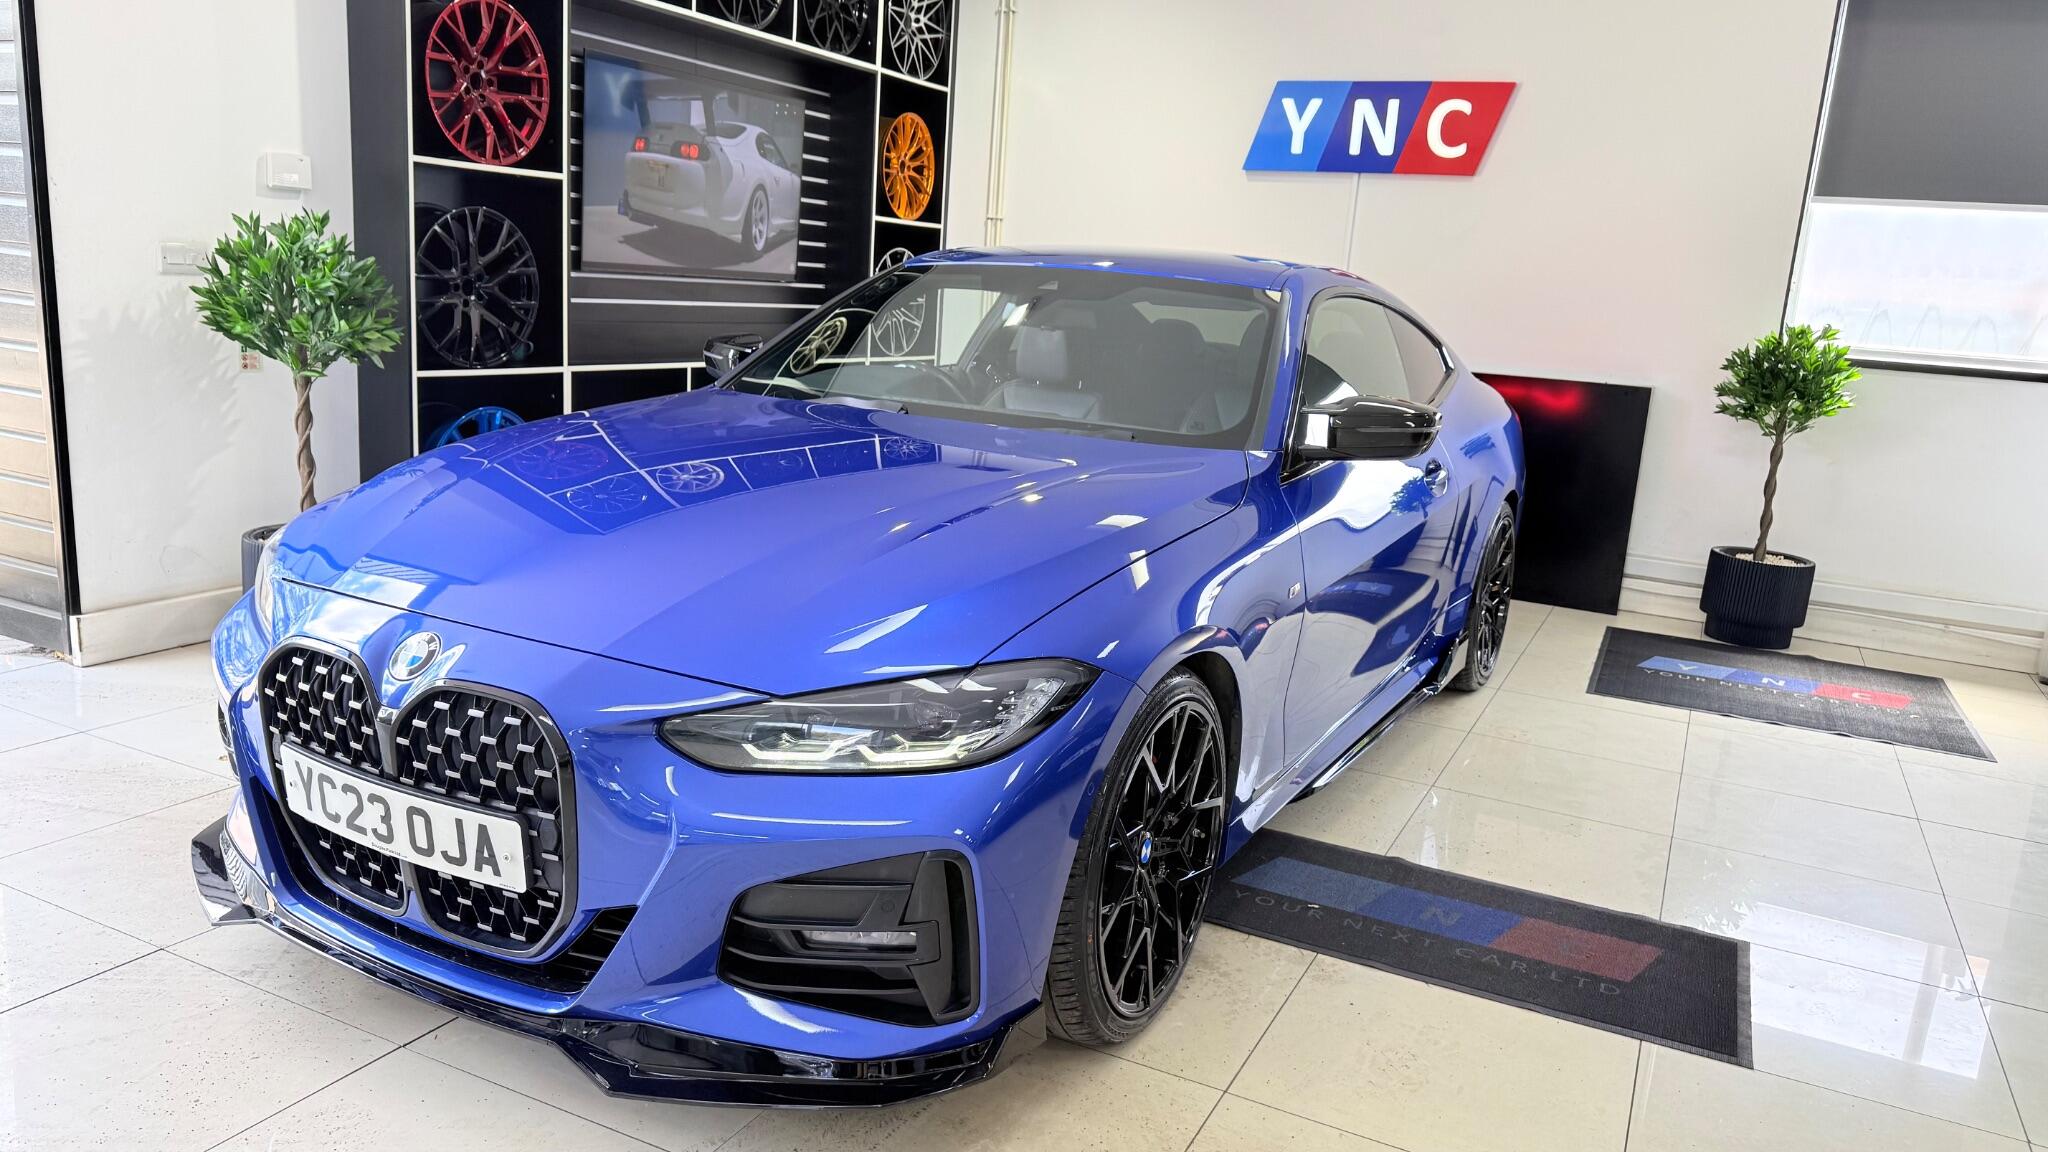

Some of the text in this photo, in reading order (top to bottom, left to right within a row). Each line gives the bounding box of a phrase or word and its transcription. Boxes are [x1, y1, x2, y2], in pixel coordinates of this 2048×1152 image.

[1281, 97, 1473, 159] YNC
[1643, 667, 1707, 683] YOUR
[294, 759, 503, 878] YC23 OJA
[1235, 888, 1325, 921] YOUR
[1343, 917, 1436, 948] NEXT
[1550, 973, 1621, 996] LTD
